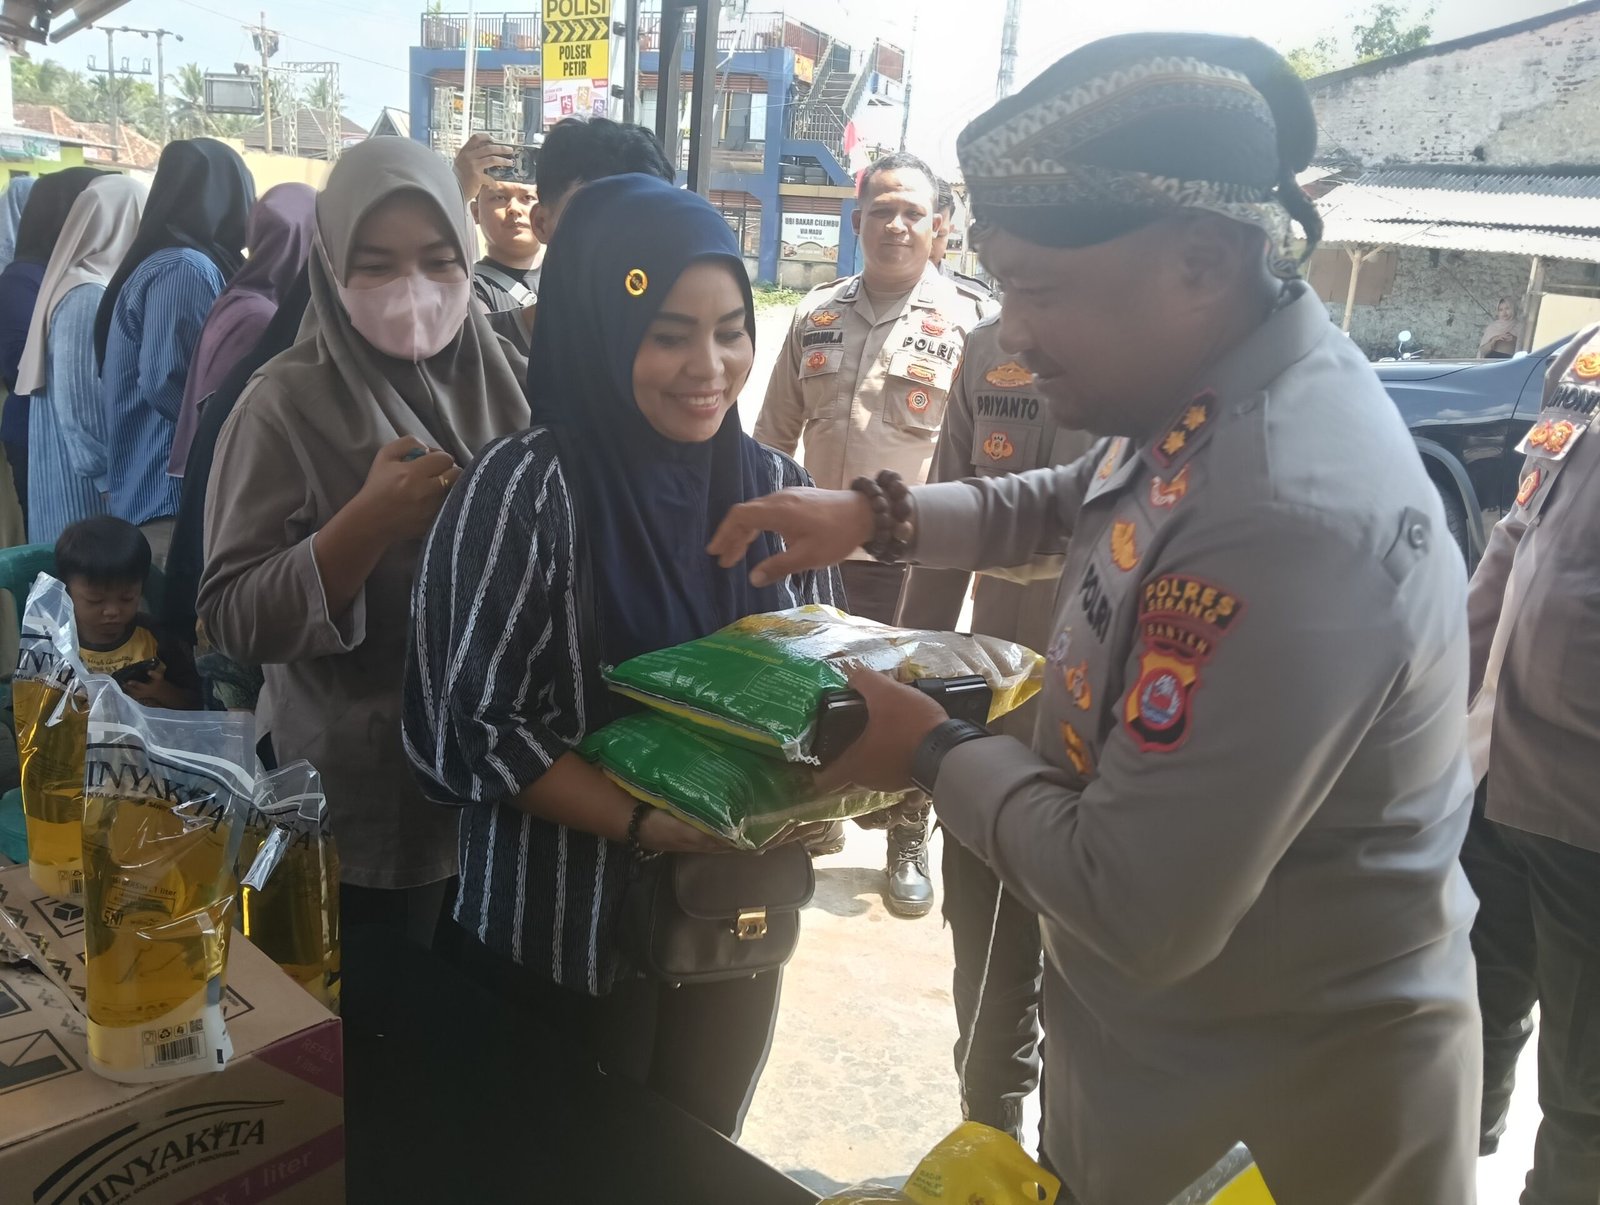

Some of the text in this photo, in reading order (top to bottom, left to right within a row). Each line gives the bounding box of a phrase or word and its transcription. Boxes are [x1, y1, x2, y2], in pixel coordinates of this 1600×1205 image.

[546, 0, 606, 18] POLISI
[559, 44, 592, 60] POLSEK
[563, 60, 587, 76] PETIR
[795, 218, 814, 226] BAKAR
[814, 219, 839, 228] CILEMBU
[902, 336, 954, 360] POLRI
[977, 395, 1039, 420] PRIYANTO
[1145, 578, 1236, 616] POLRES
[1148, 623, 1208, 654] BANTEN
[159, 887, 177, 896] liter
[103, 911, 124, 926] SNI
[263, 1150, 312, 1187] liter
